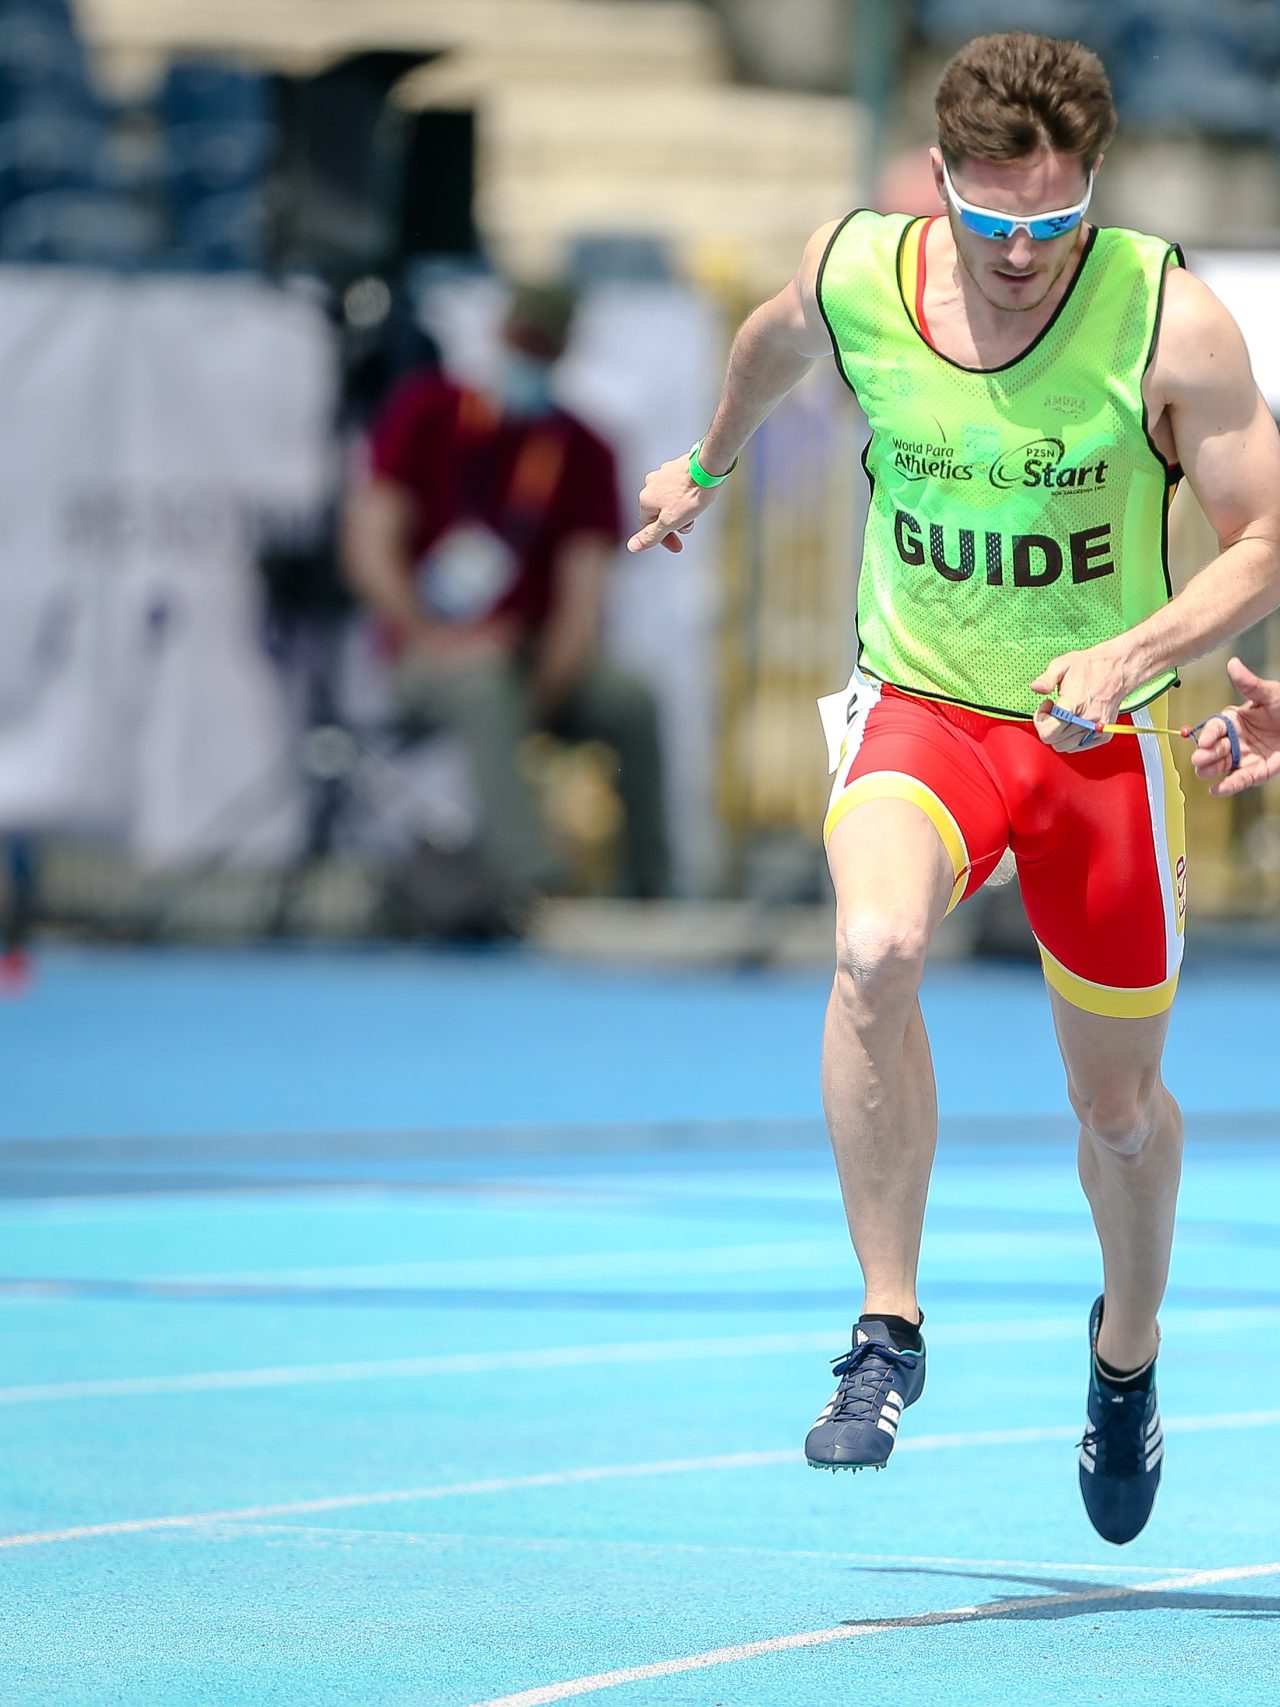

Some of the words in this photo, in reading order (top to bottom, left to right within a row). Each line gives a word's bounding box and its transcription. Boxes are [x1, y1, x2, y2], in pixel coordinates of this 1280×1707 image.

[893, 437, 923, 454] World
[926, 444, 954, 457] Para
[1026, 448, 1055, 458] PZSN
[895, 452, 973, 480] Athletics
[1023, 459, 1109, 487] Start
[894, 509, 1115, 587] GUIDE
